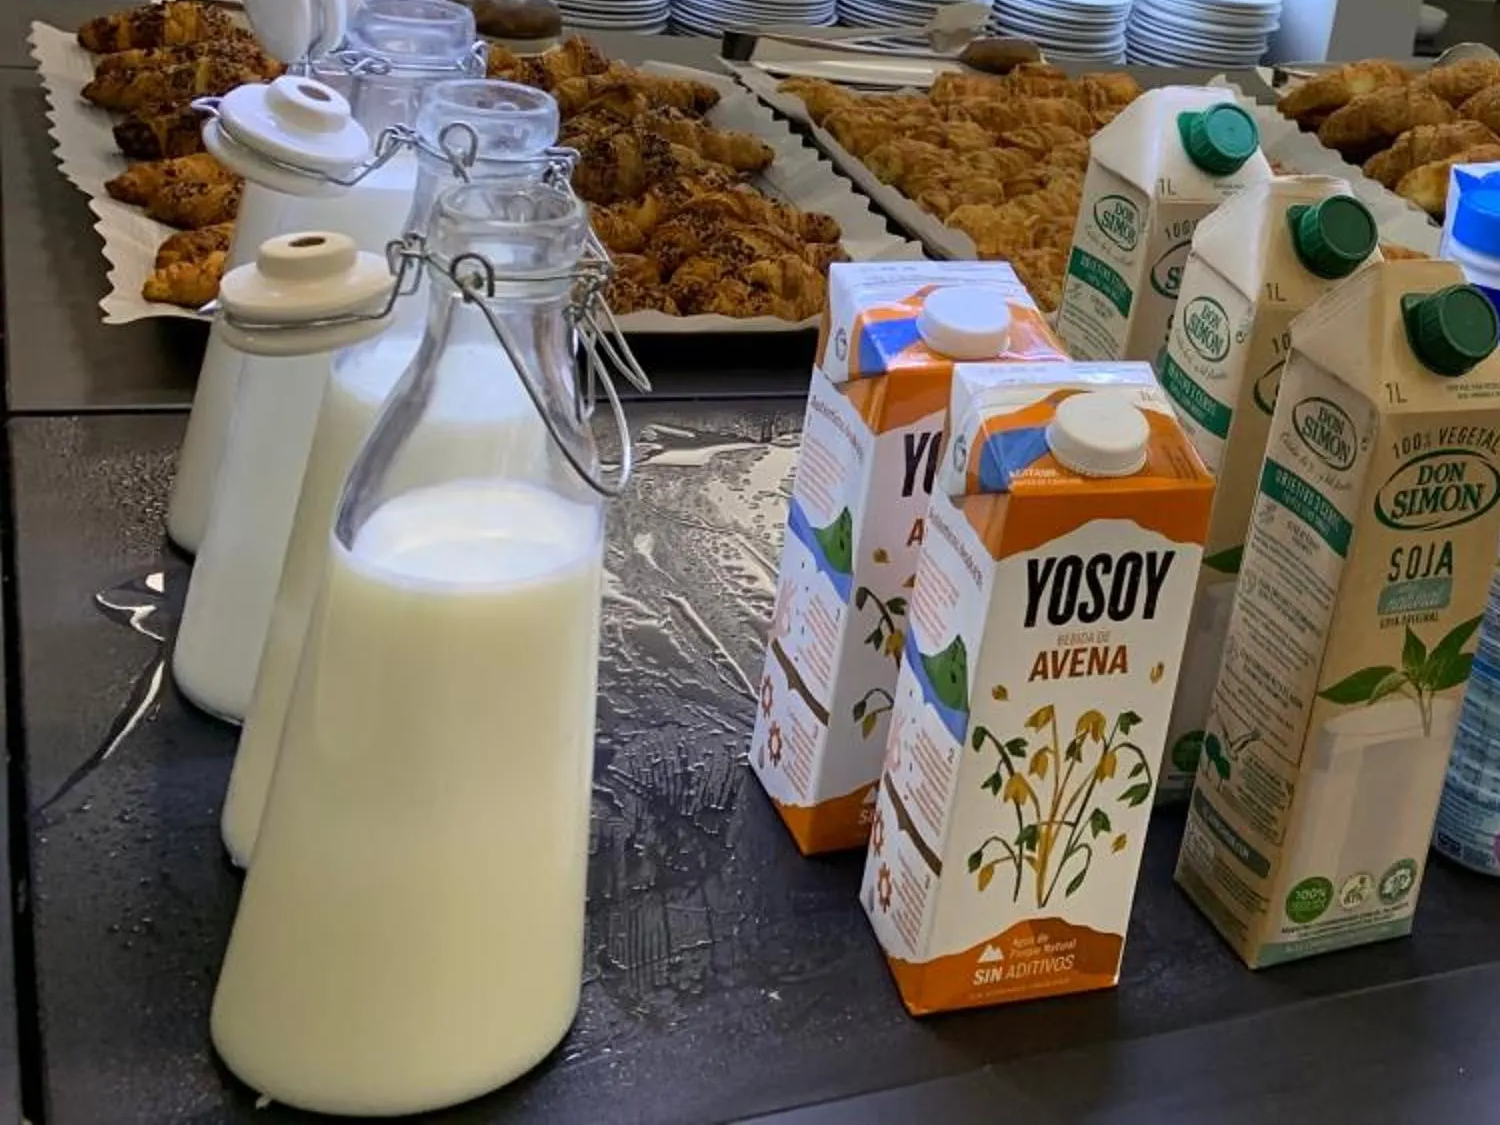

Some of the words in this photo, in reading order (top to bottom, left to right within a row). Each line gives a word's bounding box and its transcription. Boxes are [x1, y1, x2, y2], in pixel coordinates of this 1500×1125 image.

[1265, 282, 1288, 303] 1L
[1385, 382, 1409, 404] 1L
[1319, 406, 1345, 436] DON
[1301, 414, 1351, 464] SIMON
[1391, 431, 1432, 460] 100%
[1416, 462, 1467, 486] DON
[1390, 483, 1486, 520] SIMON
[1387, 539, 1454, 582] SOJA
[1023, 549, 1176, 628] YOSOY
[1027, 644, 1129, 683] AVENA
[973, 967, 1003, 986] SIN
[1004, 954, 1076, 981] ADITIVOS
